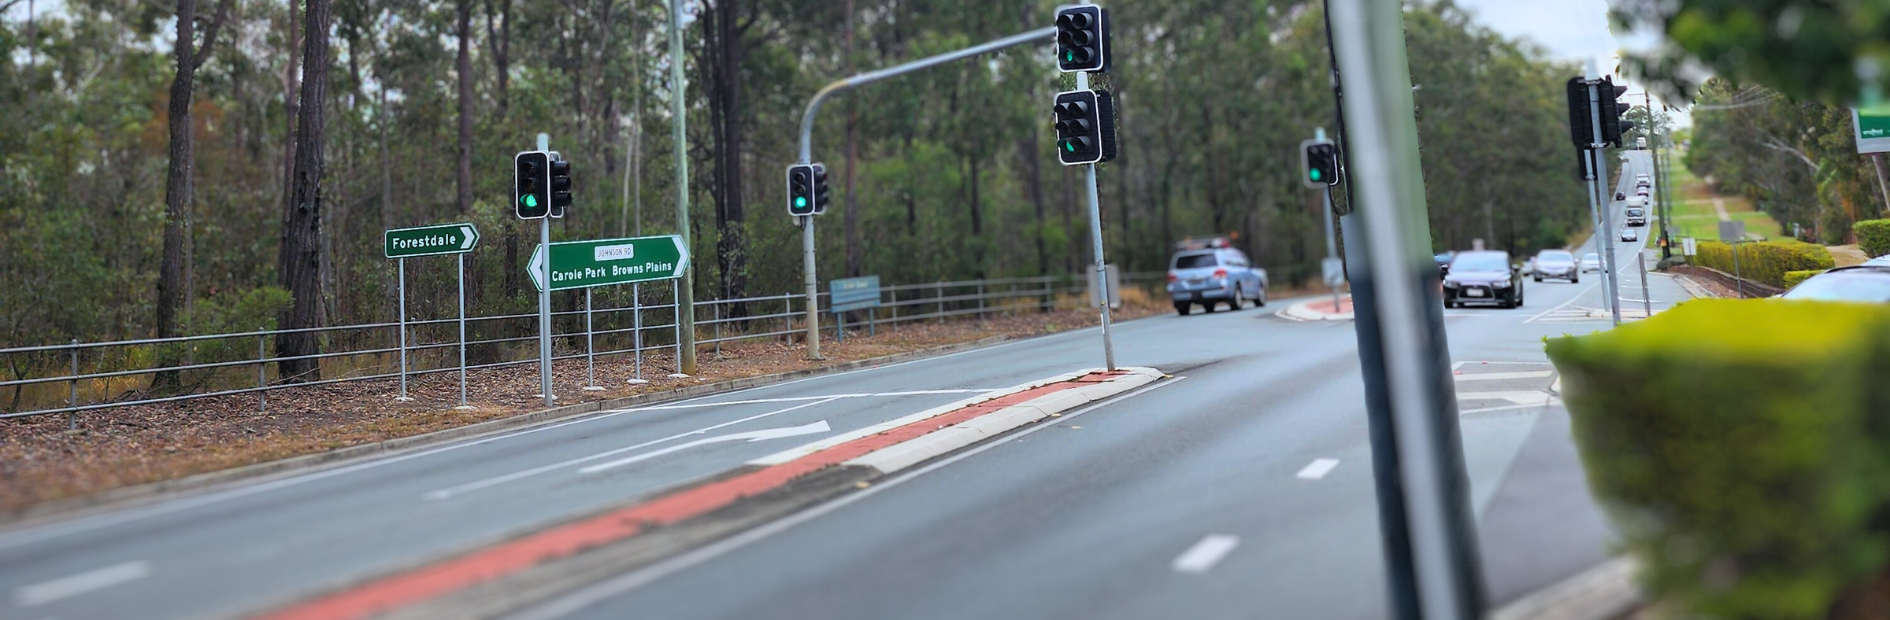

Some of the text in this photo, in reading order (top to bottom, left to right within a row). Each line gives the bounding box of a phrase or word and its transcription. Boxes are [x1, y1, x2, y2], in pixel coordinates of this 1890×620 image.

[392, 233, 456, 249] Forestdale
[597, 247, 632, 257] JOHNSON RD
[552, 261, 672, 281] Carole Park Browns Plains
